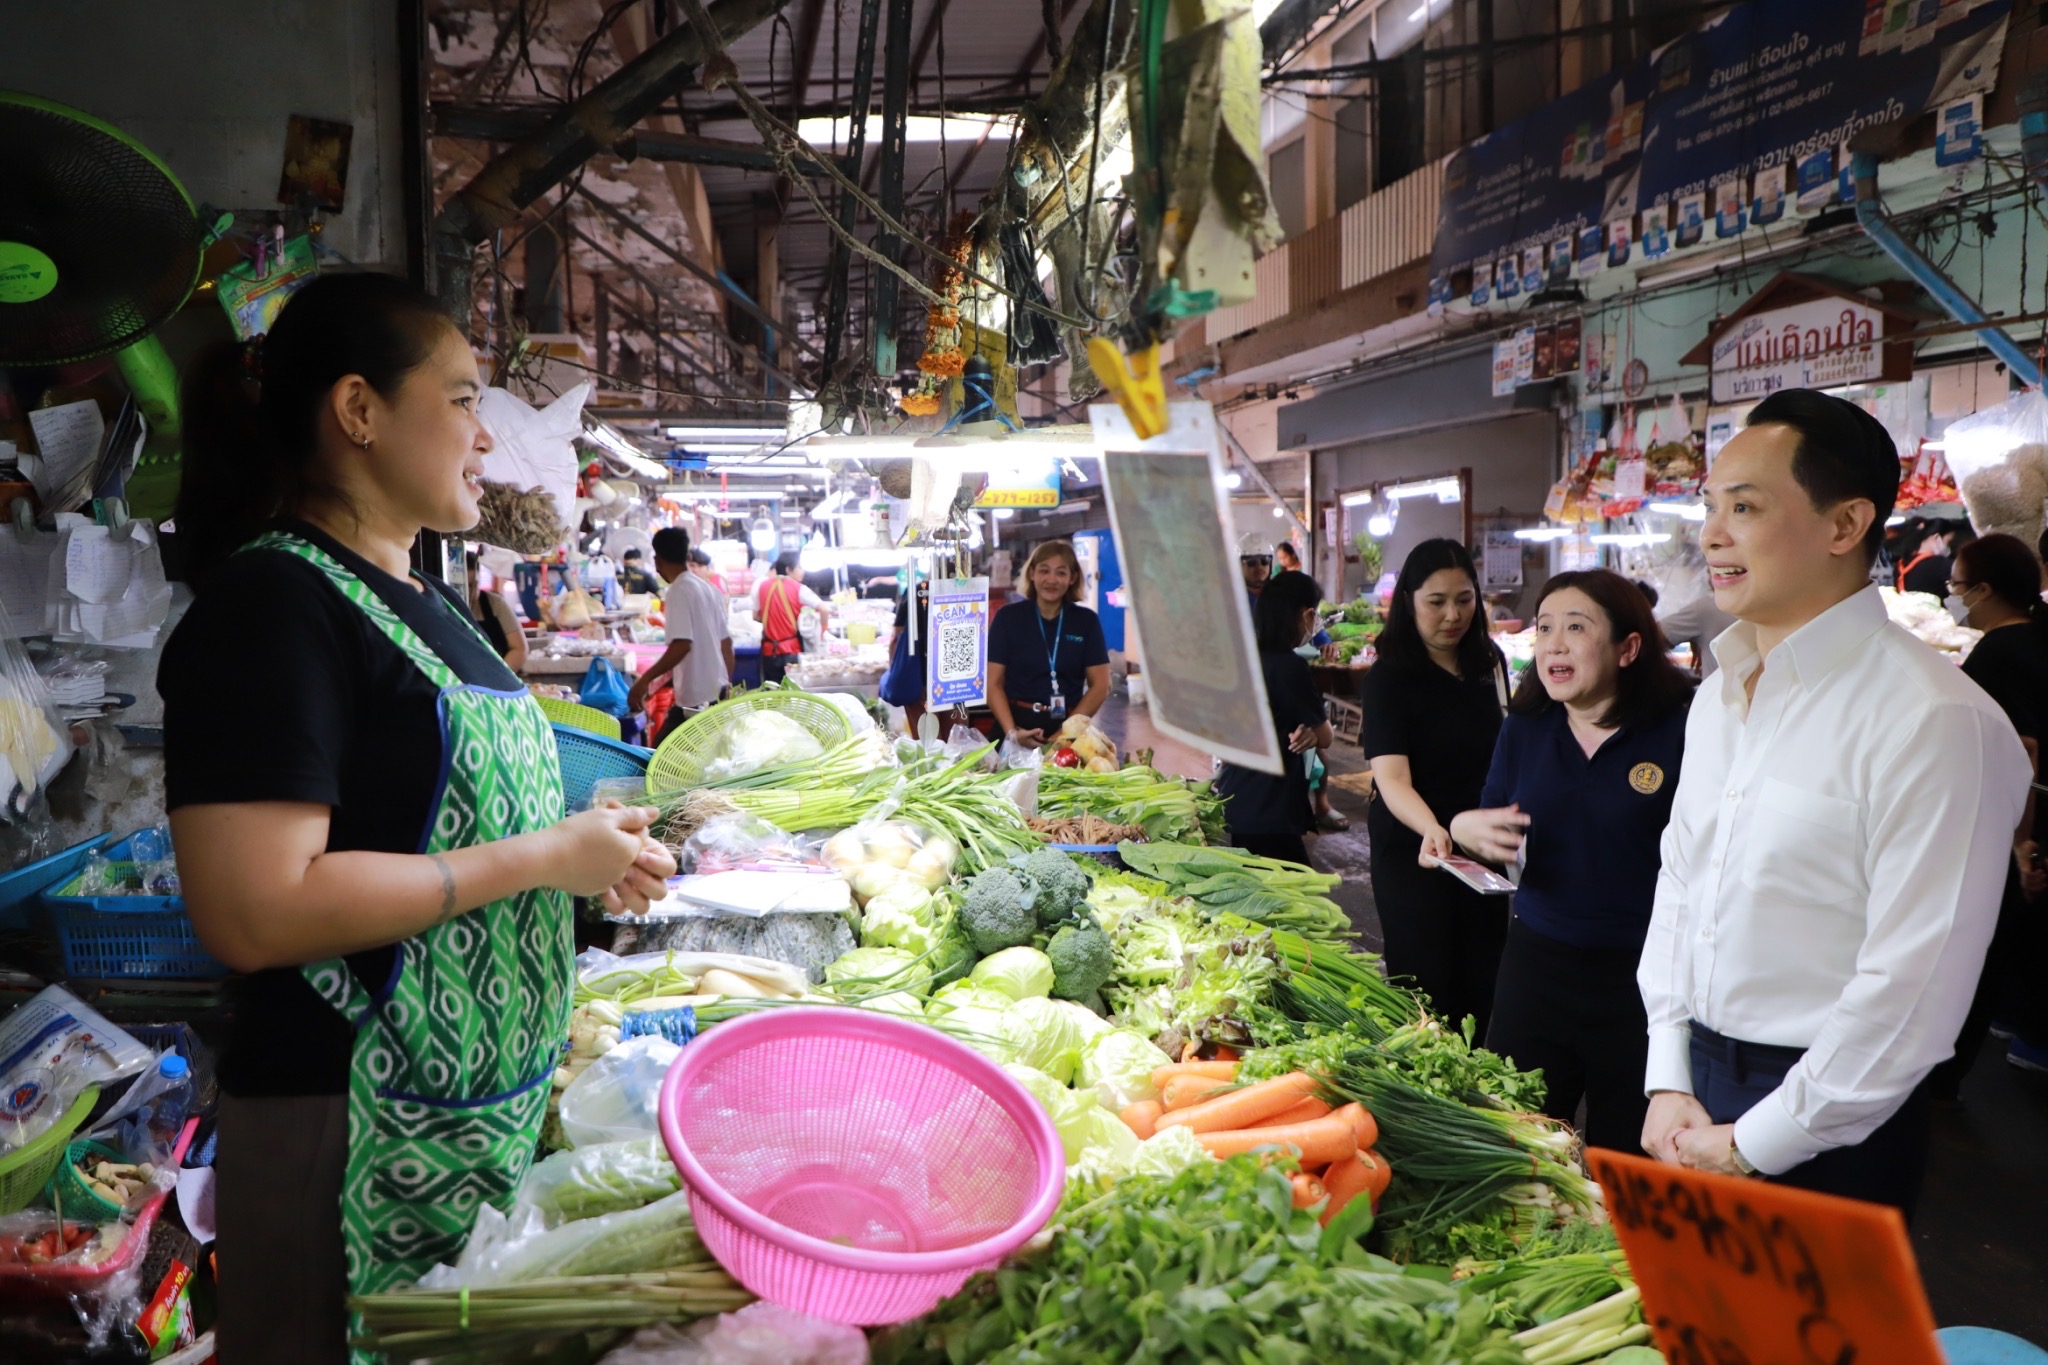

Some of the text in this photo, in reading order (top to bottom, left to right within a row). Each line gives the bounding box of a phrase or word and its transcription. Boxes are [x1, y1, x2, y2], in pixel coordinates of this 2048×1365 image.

[1736, 309, 1874, 373] แม่เตือนใจ
[936, 604, 966, 624] SCAN
[175, 1271, 185, 1286] 10
